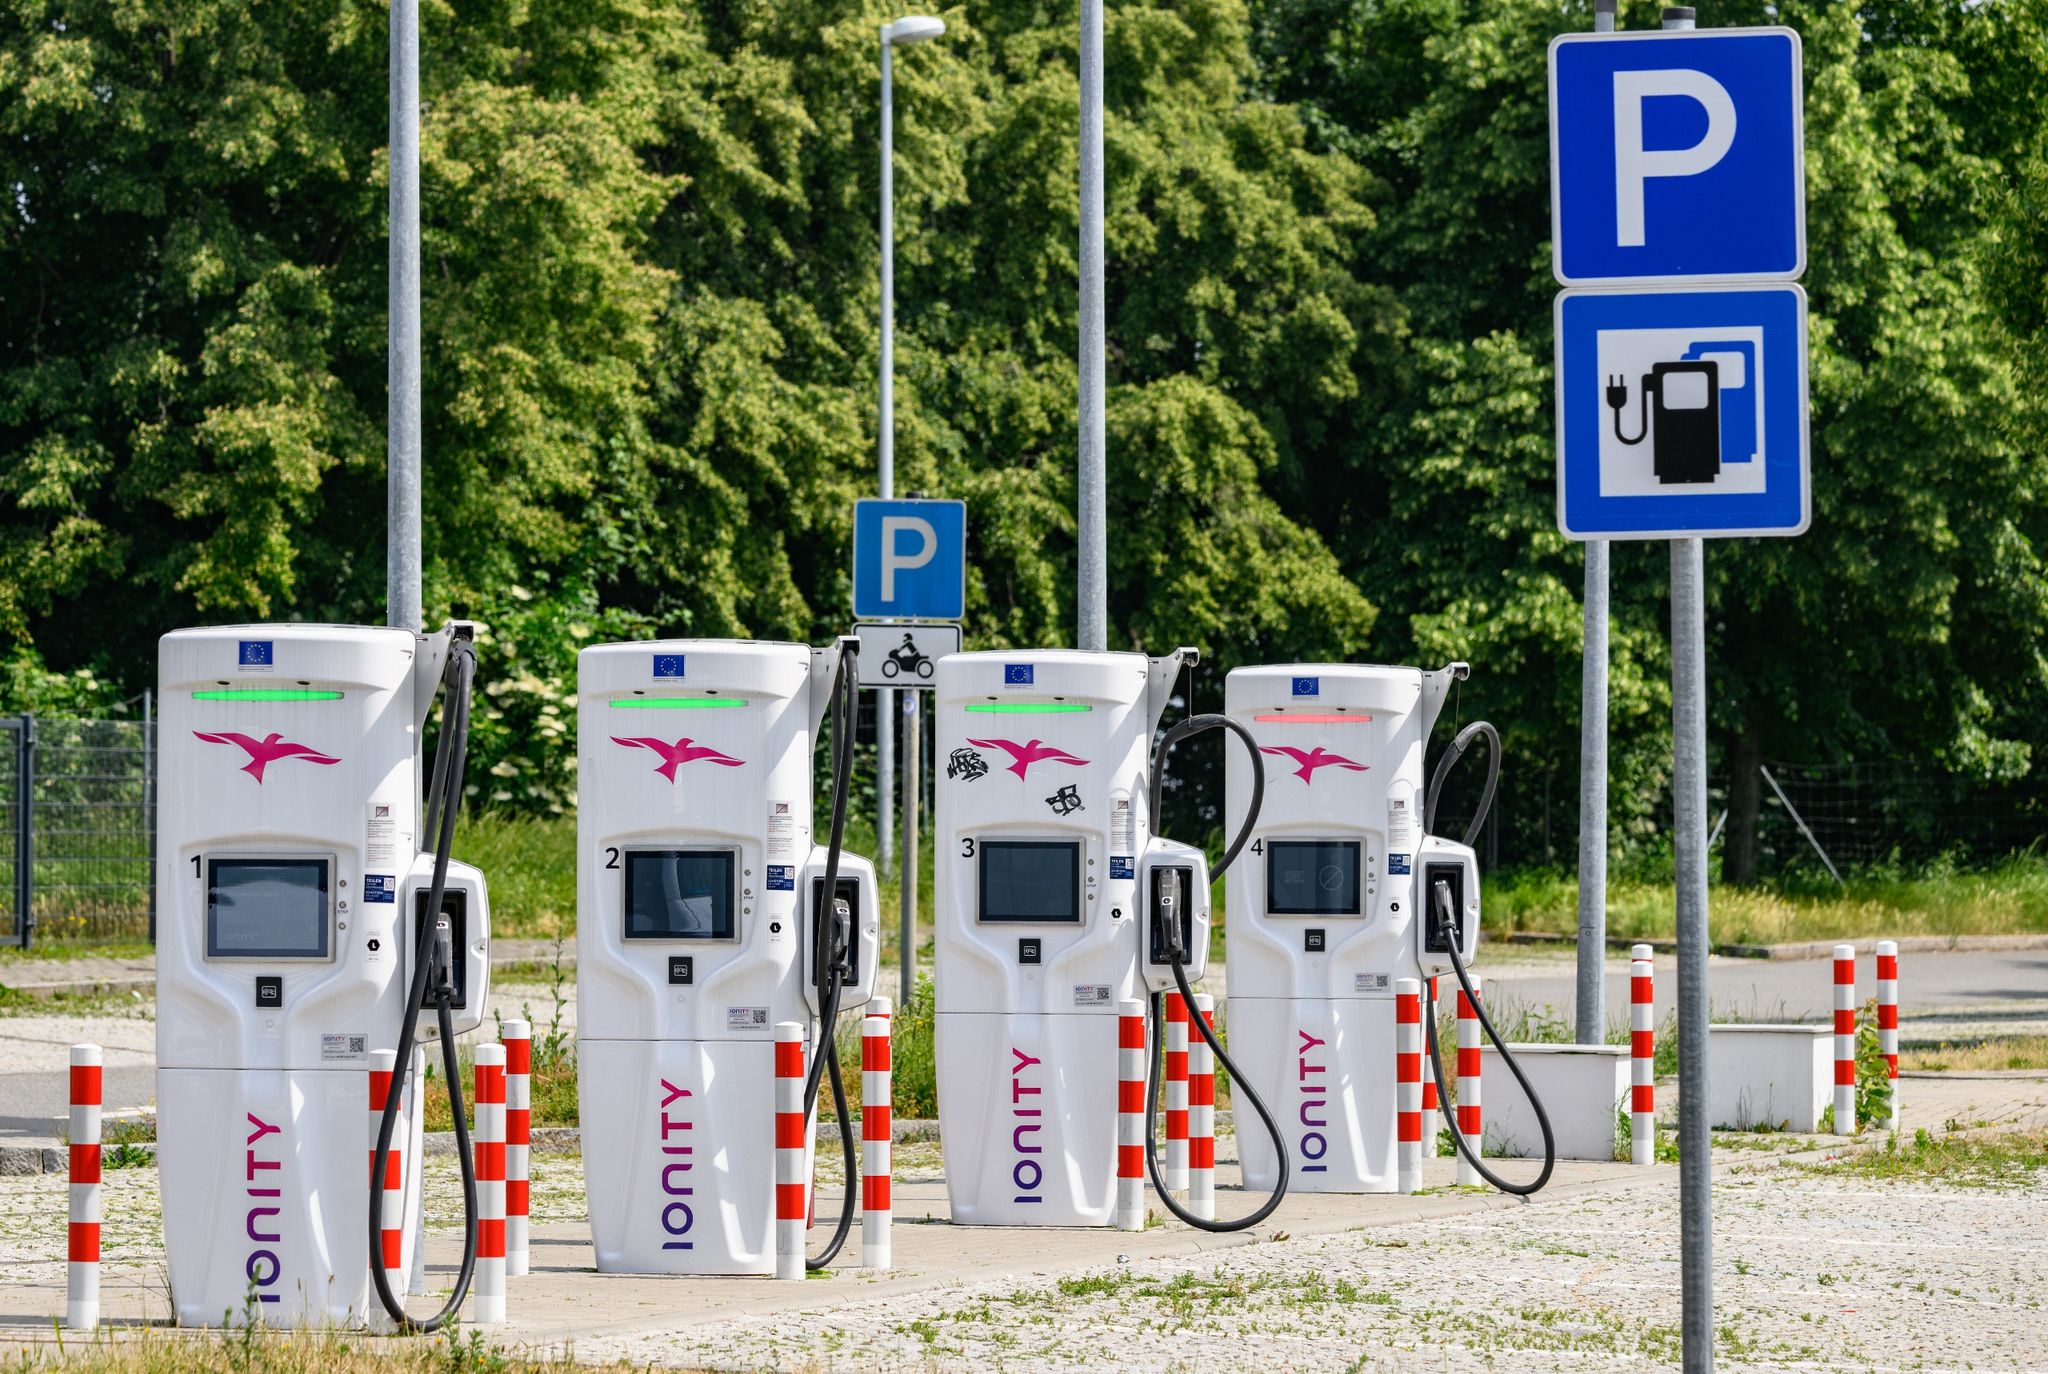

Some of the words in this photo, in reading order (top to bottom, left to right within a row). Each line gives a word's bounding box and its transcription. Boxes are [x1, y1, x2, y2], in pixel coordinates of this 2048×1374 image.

[1613, 68, 1737, 247] P
[881, 516, 938, 602] P
[191, 855, 201, 878] 1
[605, 847, 620, 869] 2
[961, 837, 975, 858] 3
[1251, 838, 1263, 856] 4
[1012, 1047, 1042, 1203] IONITY
[1299, 1029, 1327, 1172] IONITY
[246, 1112, 281, 1302] IONITY
[661, 1078, 693, 1250] IONITY
